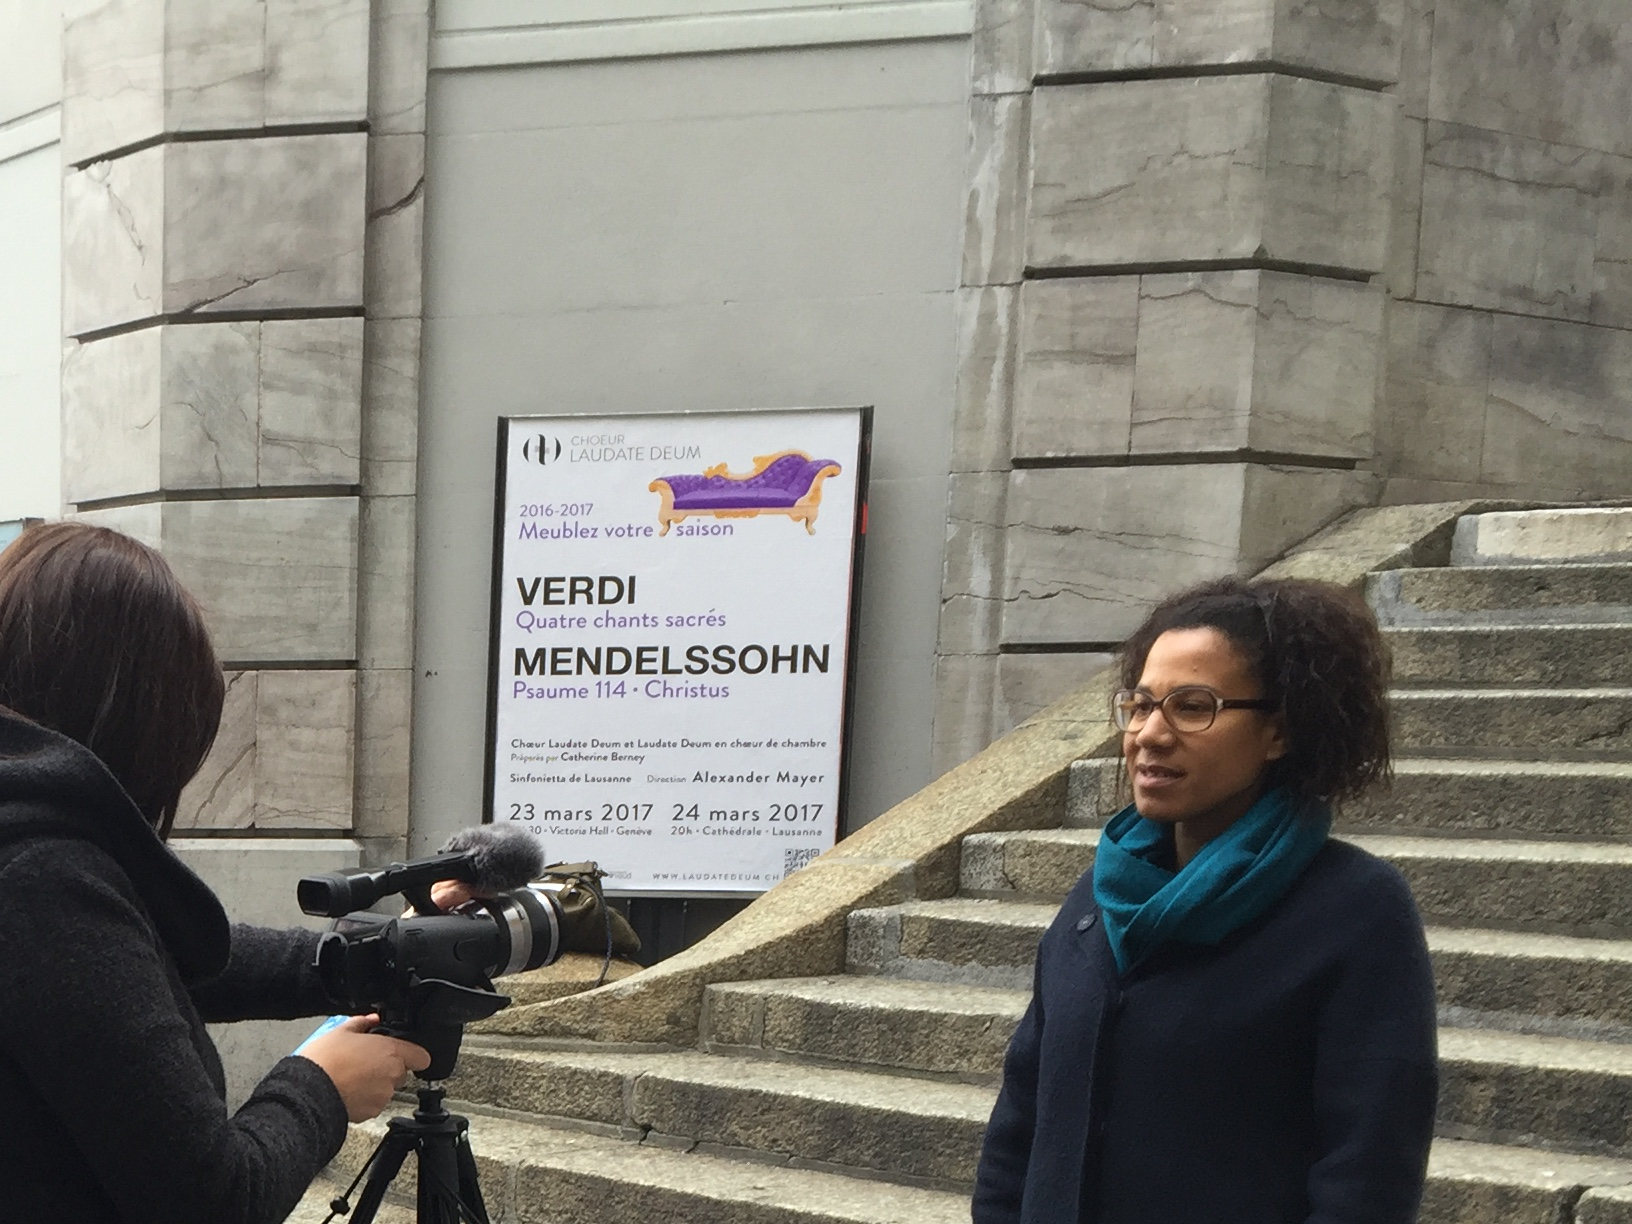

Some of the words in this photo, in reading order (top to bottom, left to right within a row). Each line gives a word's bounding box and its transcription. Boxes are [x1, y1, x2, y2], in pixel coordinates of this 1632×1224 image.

[571, 435, 625, 446] CHOEUR
[570, 446, 645, 463] LAUDATE
[650, 445, 701, 460] DEUM
[519, 503, 594, 518] 2016-2017
[518, 520, 599, 540] Meublez
[605, 524, 654, 539] votre
[676, 518, 734, 538] saison
[516, 575, 636, 606] VERDI
[516, 611, 588, 634] Quatre
[593, 610, 659, 629] chants
[665, 608, 727, 628] sacrés
[513, 644, 830, 676] MENDELSSOHN
[513, 681, 589, 700] Psaume
[595, 680, 627, 699] 114
[644, 679, 730, 699] Christus
[548, 738, 588, 749] Laudate
[591, 738, 621, 749] Deum
[624, 739, 634, 748] et
[637, 738, 678, 749] Laudate
[680, 738, 712, 748] Deum
[714, 740, 727, 748] en
[766, 738, 778, 748] de
[781, 738, 827, 748] chambre
[560, 752, 608, 762] Catherine
[611, 752, 645, 765] Berney
[510, 773, 566, 783] Sinfonietta
[569, 773, 581, 783] de
[584, 773, 632, 783] Lausanne
[646, 774, 687, 784] Direction
[692, 770, 770, 783] Alexander
[776, 771, 825, 788] Mayer
[510, 803, 535, 821] 23
[544, 809, 593, 822] mars
[601, 803, 654, 822] 2017
[671, 803, 700, 821] 24
[709, 809, 760, 822] mars
[769, 803, 823, 822] 2017
[549, 826, 587, 836] Victoria
[589, 826, 609, 835] Hall
[616, 826, 652, 836] Genève
[670, 826, 693, 835] 20h
[702, 826, 762, 837] Cathédrale
[772, 827, 823, 837] Lausanne
[652, 872, 780, 881] WWW.LAUDATEDEUMCH
